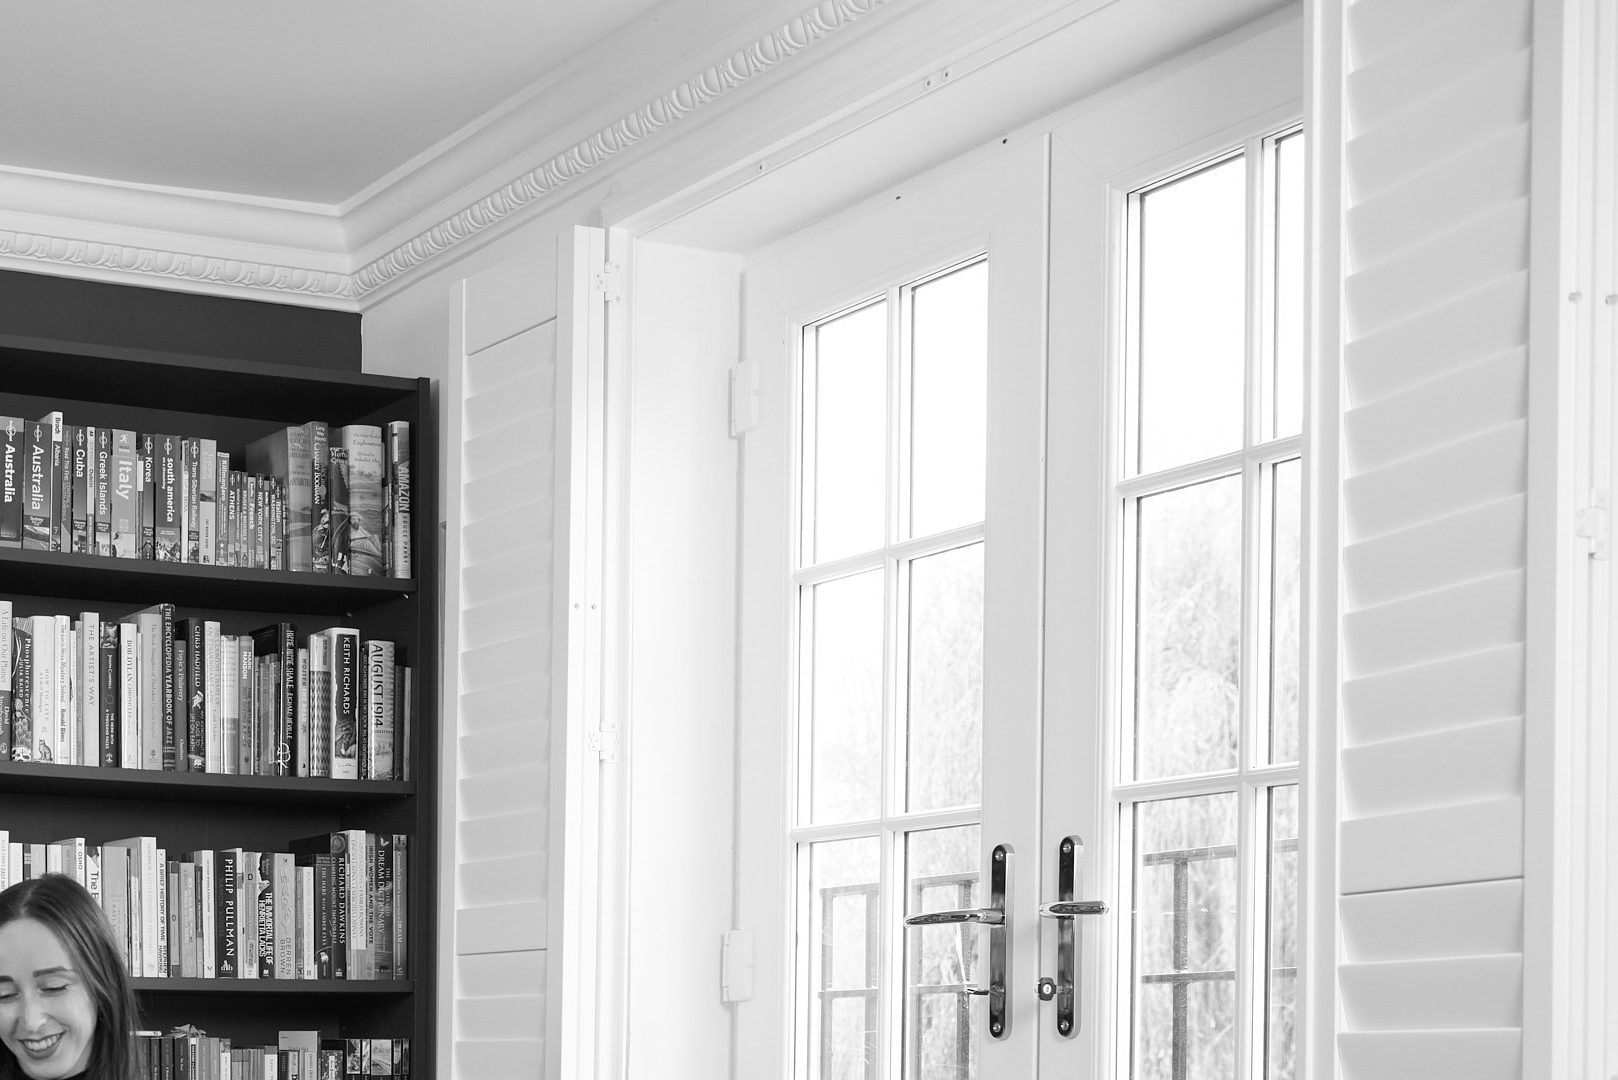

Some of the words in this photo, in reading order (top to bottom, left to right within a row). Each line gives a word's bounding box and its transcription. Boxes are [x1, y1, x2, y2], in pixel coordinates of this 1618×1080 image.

[4, 444, 15, 503] Australia
[31, 445, 44, 510] Australia
[76, 449, 85, 477] Cuba
[99, 452, 107, 479] Greek
[116, 460, 133, 499] Italy
[145, 457, 153, 482] Korea
[167, 458, 175, 485] south
[99, 482, 107, 515] Islands
[166, 488, 174, 522] america
[398, 467, 410, 511] AMAZON
[371, 644, 383, 698] AUGUST
[373, 702, 384, 727] 1914
[225, 859, 234, 894] PHILIP
[225, 900, 234, 956] PULLMAN
